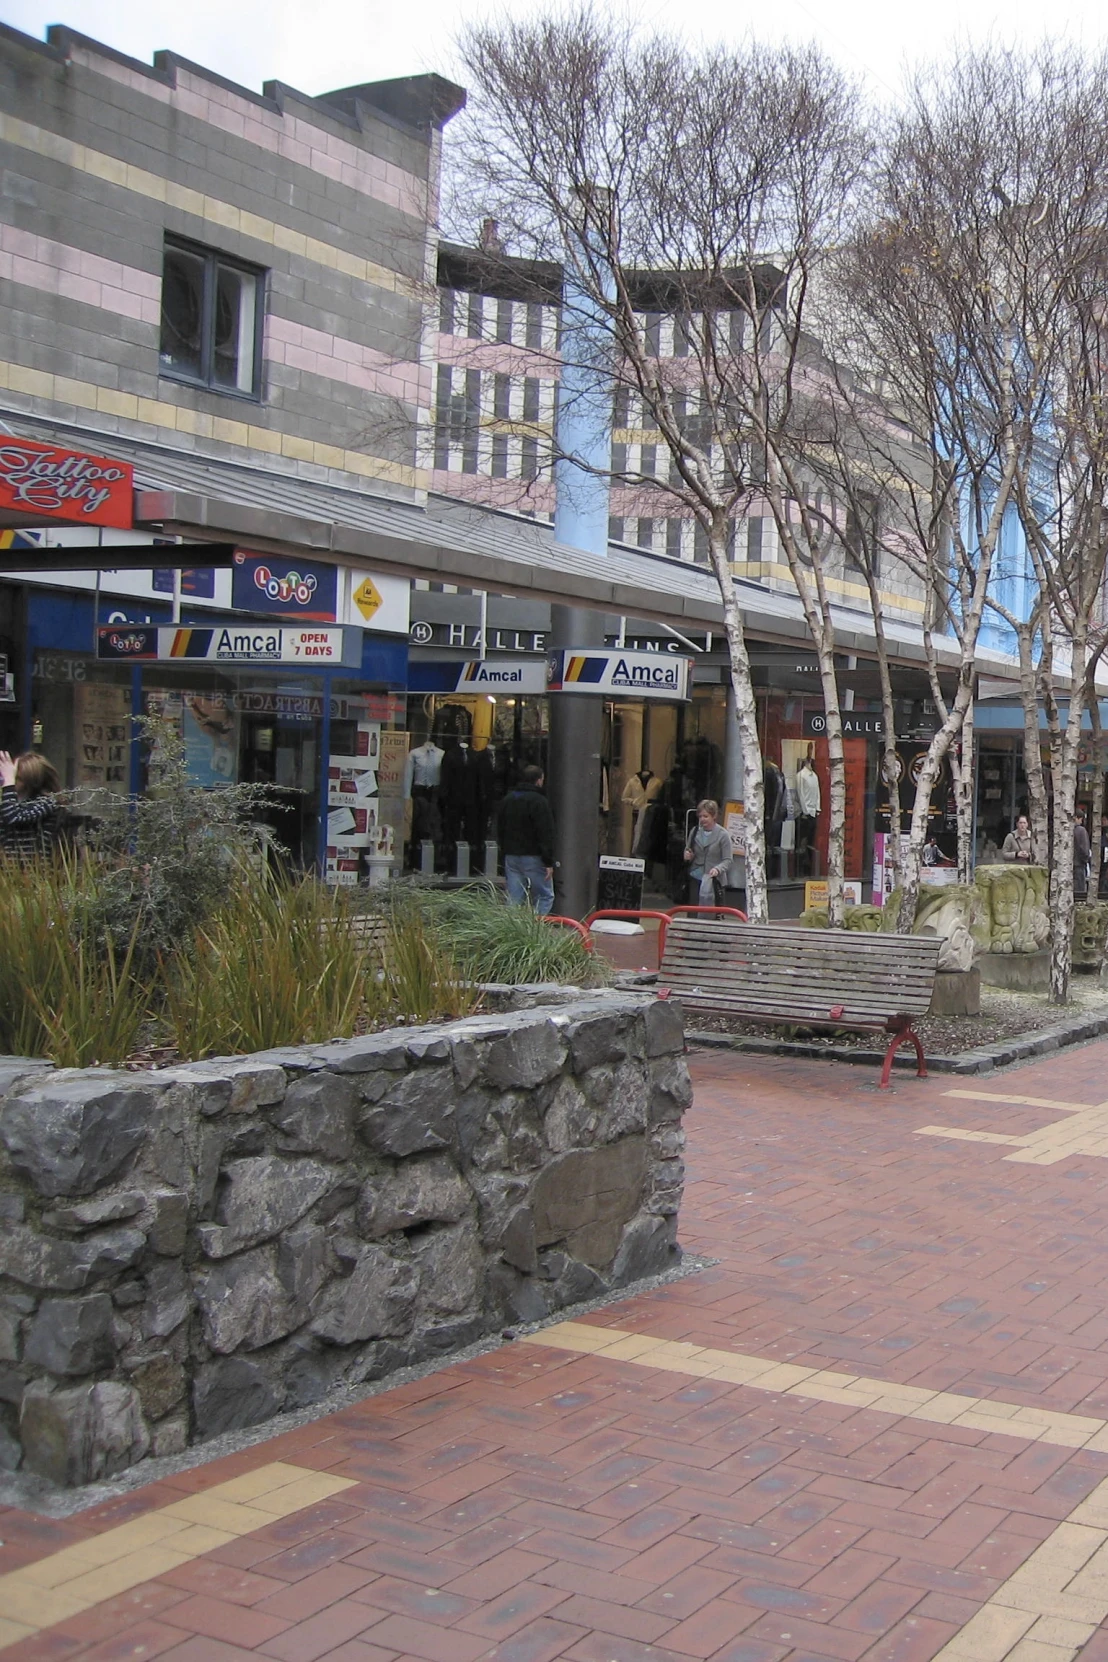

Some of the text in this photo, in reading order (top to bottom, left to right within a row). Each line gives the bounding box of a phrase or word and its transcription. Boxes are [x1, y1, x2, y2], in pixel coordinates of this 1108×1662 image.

[0, 446, 125, 481] Tattoo
[8, 472, 110, 512] City
[257, 567, 310, 602] LOTTO
[217, 629, 282, 651] Amcal
[300, 633, 328, 643] OPEN
[295, 646, 332, 656] 7 DAYS
[478, 668, 522, 682] Amcal
[612, 659, 679, 683] Amcal
